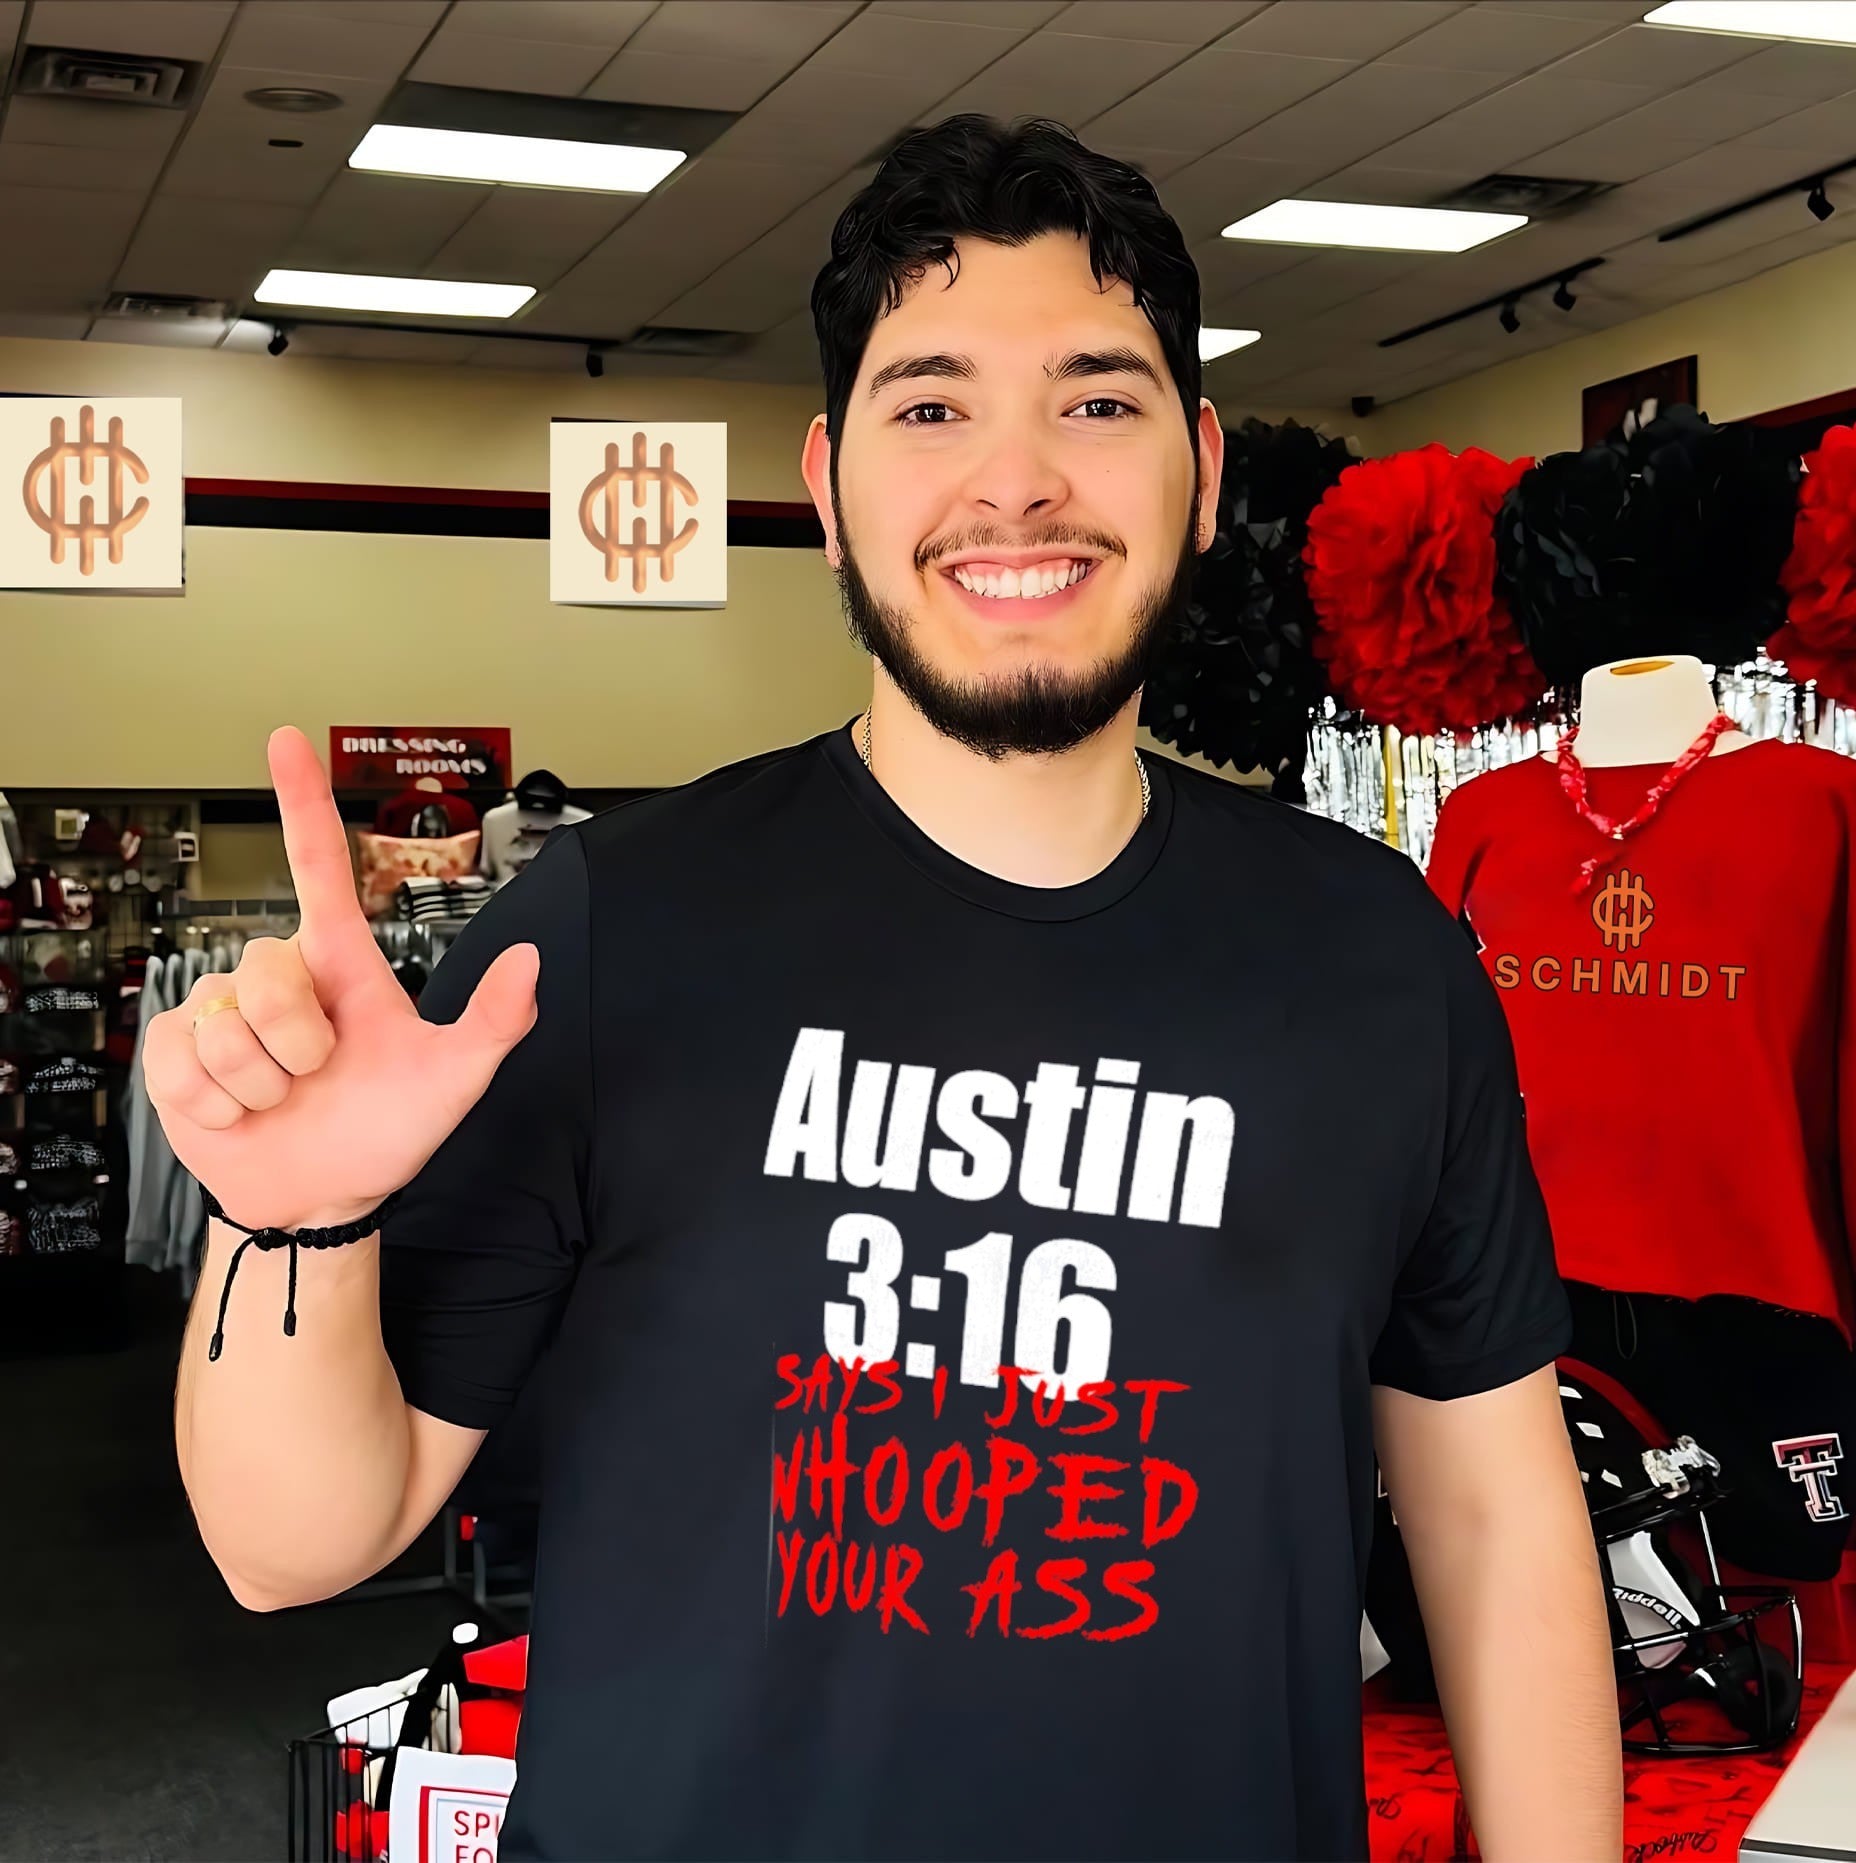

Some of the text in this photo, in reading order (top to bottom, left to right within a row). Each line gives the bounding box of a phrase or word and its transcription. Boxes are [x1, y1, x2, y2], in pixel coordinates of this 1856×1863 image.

[342, 737, 467, 754] DRESSING
[396, 758, 487, 775] ROOMS
[1494, 954, 1747, 1000] SCHMIDT
[763, 1027, 1235, 1228] Austin
[823, 1212, 1117, 1402] 3:16
[775, 1353, 1191, 1443] SAYS I JUST
[776, 1527, 1160, 1643] YOUR ASS
